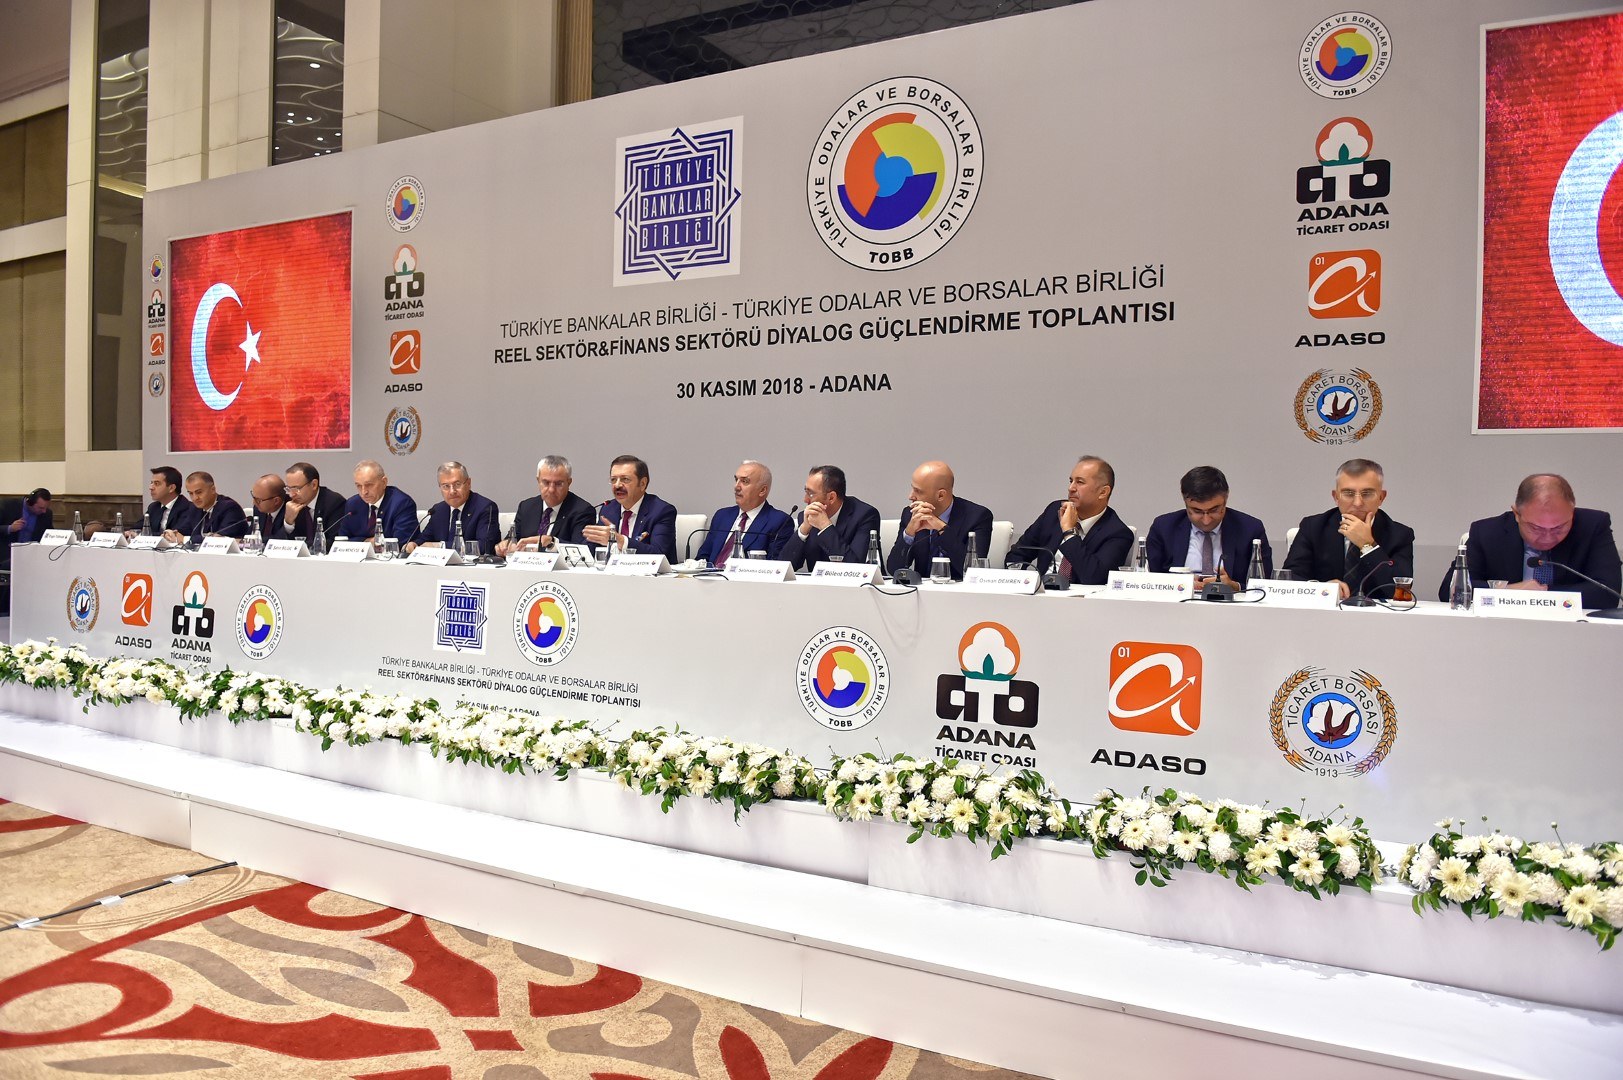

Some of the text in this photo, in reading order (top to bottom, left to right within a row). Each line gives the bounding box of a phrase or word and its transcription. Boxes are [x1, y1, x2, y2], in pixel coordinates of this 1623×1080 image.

[1304, 22, 1332, 53] ODALAR
[1335, 16, 1347, 24] VE
[1352, 15, 1388, 47] BORSALAR
[1332, 87, 1357, 96] TOBB
[643, 157, 713, 189] TÜRKİYE
[814, 86, 975, 249] TÜRKİYE ODALAR VE BORSALAR BİRLİĞİ
[642, 188, 712, 219] BANKALAR
[1296, 202, 1390, 223] ADANA
[641, 216, 712, 249] BİRLİĞİ
[1296, 220, 1390, 236] TİCARET ODASI
[868, 247, 914, 264] TOBB
[1314, 256, 1325, 266] 01
[385, 299, 424, 312] ADANA
[500, 316, 563, 339] TÜRKİYE
[566, 310, 651, 334] BANKALAR
[656, 301, 717, 326] BİRLİĞİ
[732, 294, 813, 320] TÜRKİYE
[818, 289, 902, 313] ODALAR
[908, 286, 937, 306] VE
[943, 276, 1068, 304] BORSALAR
[1076, 264, 1165, 294] BİRLİĞİ
[385, 311, 424, 321] TİCARET ODASI
[494, 301, 1176, 364] REEL SEKTÖR&FİNANS SEKTÖRÜ DİYALOG GÜÇLENDİRME TOPLANTISI
[1294, 332, 1386, 348] ADASO
[384, 382, 423, 393] ADASO
[676, 382, 696, 399] 30
[700, 379, 757, 398] KASIM
[762, 377, 803, 396] 2018
[820, 373, 892, 393] ADANA
[1306, 376, 1370, 414] TİCARET BORSASI
[1318, 423, 1355, 436] ADANA
[1326, 438, 1343, 446] 1913
[1268, 586, 1295, 595] Turgut
[1297, 587, 1316, 595] BOZ
[1498, 598, 1527, 606] Hakan
[1530, 598, 1556, 607] EKEN
[115, 635, 152, 649] ADASO
[171, 638, 212, 652] ADANA
[171, 651, 212, 664] TİCARET ODASI
[802, 634, 831, 666] ODALAR
[851, 633, 885, 678] BORSALAR
[1118, 646, 1130, 658] 01
[382, 656, 410, 668] TÜRKİYE
[411, 659, 448, 672] BANKALAR
[450, 664, 475, 675] BİRLİĞİ
[482, 667, 513, 680] TÜRKİYE
[515, 671, 547, 683] ODALAR
[549, 675, 559, 685] VE
[561, 677, 606, 690] BORSALAR
[608, 680, 639, 694] BİRLİĞİ
[378, 668, 641, 708] REEL SEKTÖR&FİNANS SEKTÖRÜ DİYALOG GÜÇLENDİRME TOPLANTISI
[1285, 678, 1379, 735] TİCARET BORSASI
[828, 718, 853, 727] TOBB
[936, 725, 1037, 751] ADANA
[935, 745, 1036, 768] TİCARET ODASI
[1090, 748, 1207, 776] ADASO
[1304, 746, 1356, 764] ADANA
[1314, 767, 1338, 778] 1913
